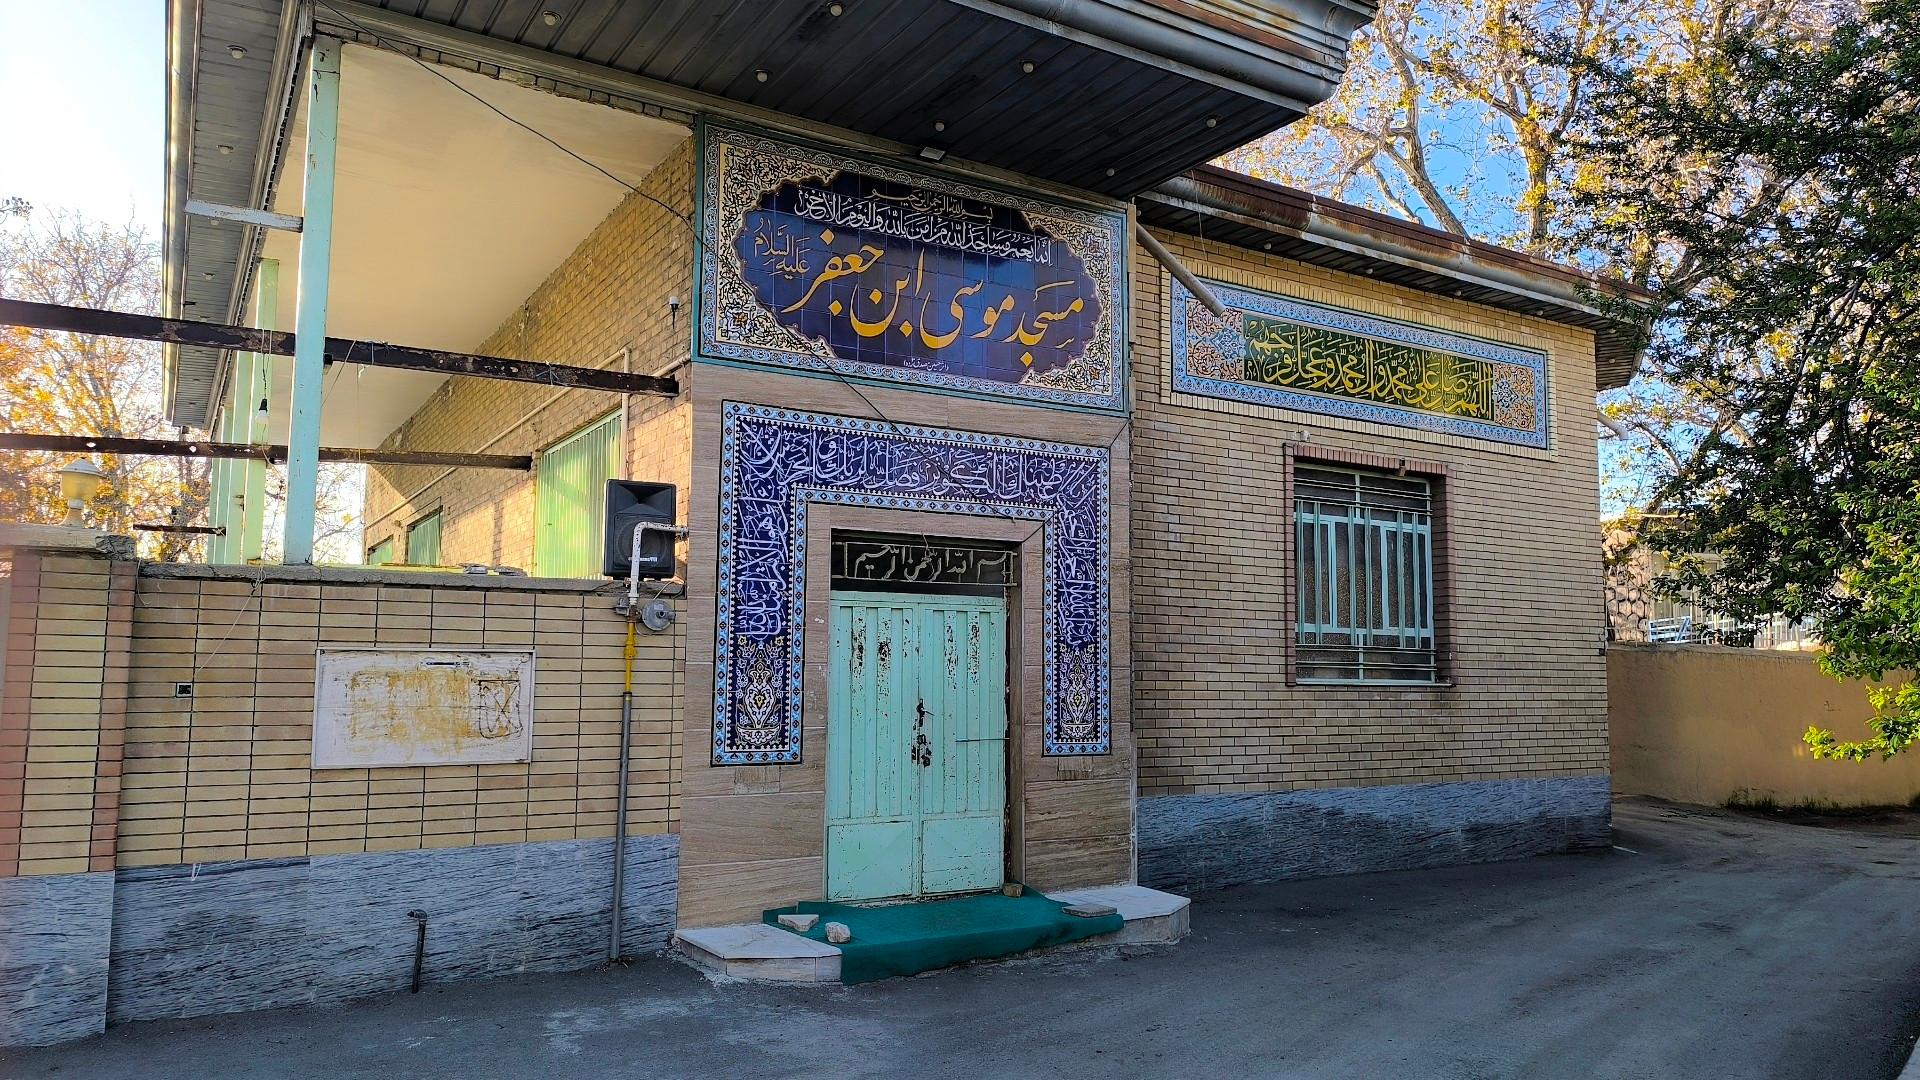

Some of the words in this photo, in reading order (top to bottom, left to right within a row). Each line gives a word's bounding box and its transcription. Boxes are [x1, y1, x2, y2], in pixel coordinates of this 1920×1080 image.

[782, 228, 885, 316] جعفر
[850, 249, 925, 338] ابن
[1004, 280, 1085, 367] مسجد
